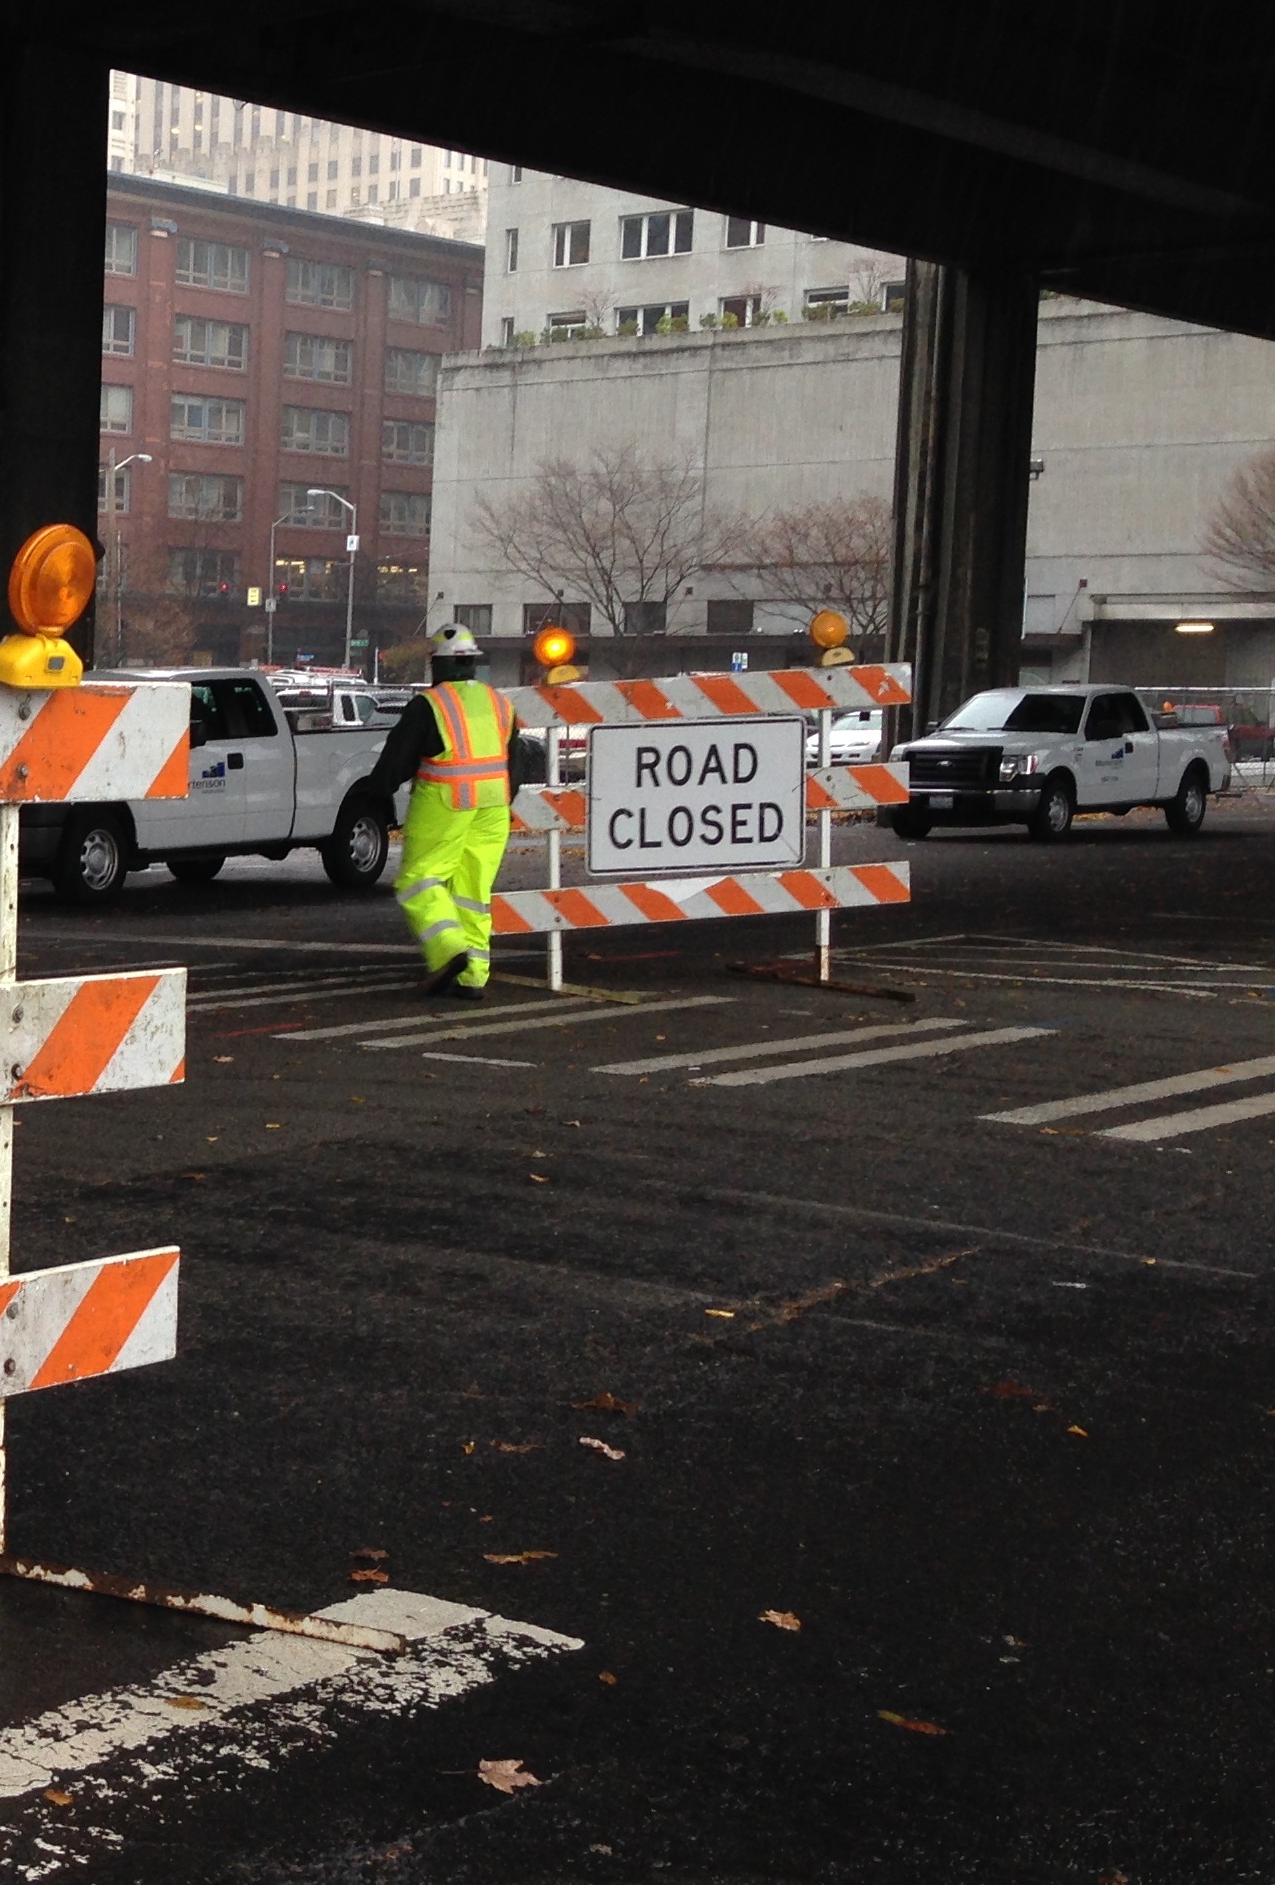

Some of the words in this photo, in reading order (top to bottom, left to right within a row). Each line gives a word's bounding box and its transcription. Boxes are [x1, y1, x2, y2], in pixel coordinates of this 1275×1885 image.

[187, 778, 226, 790] rtenson
[635, 743, 758, 788] ROAD
[609, 802, 784, 849] CLOSED
